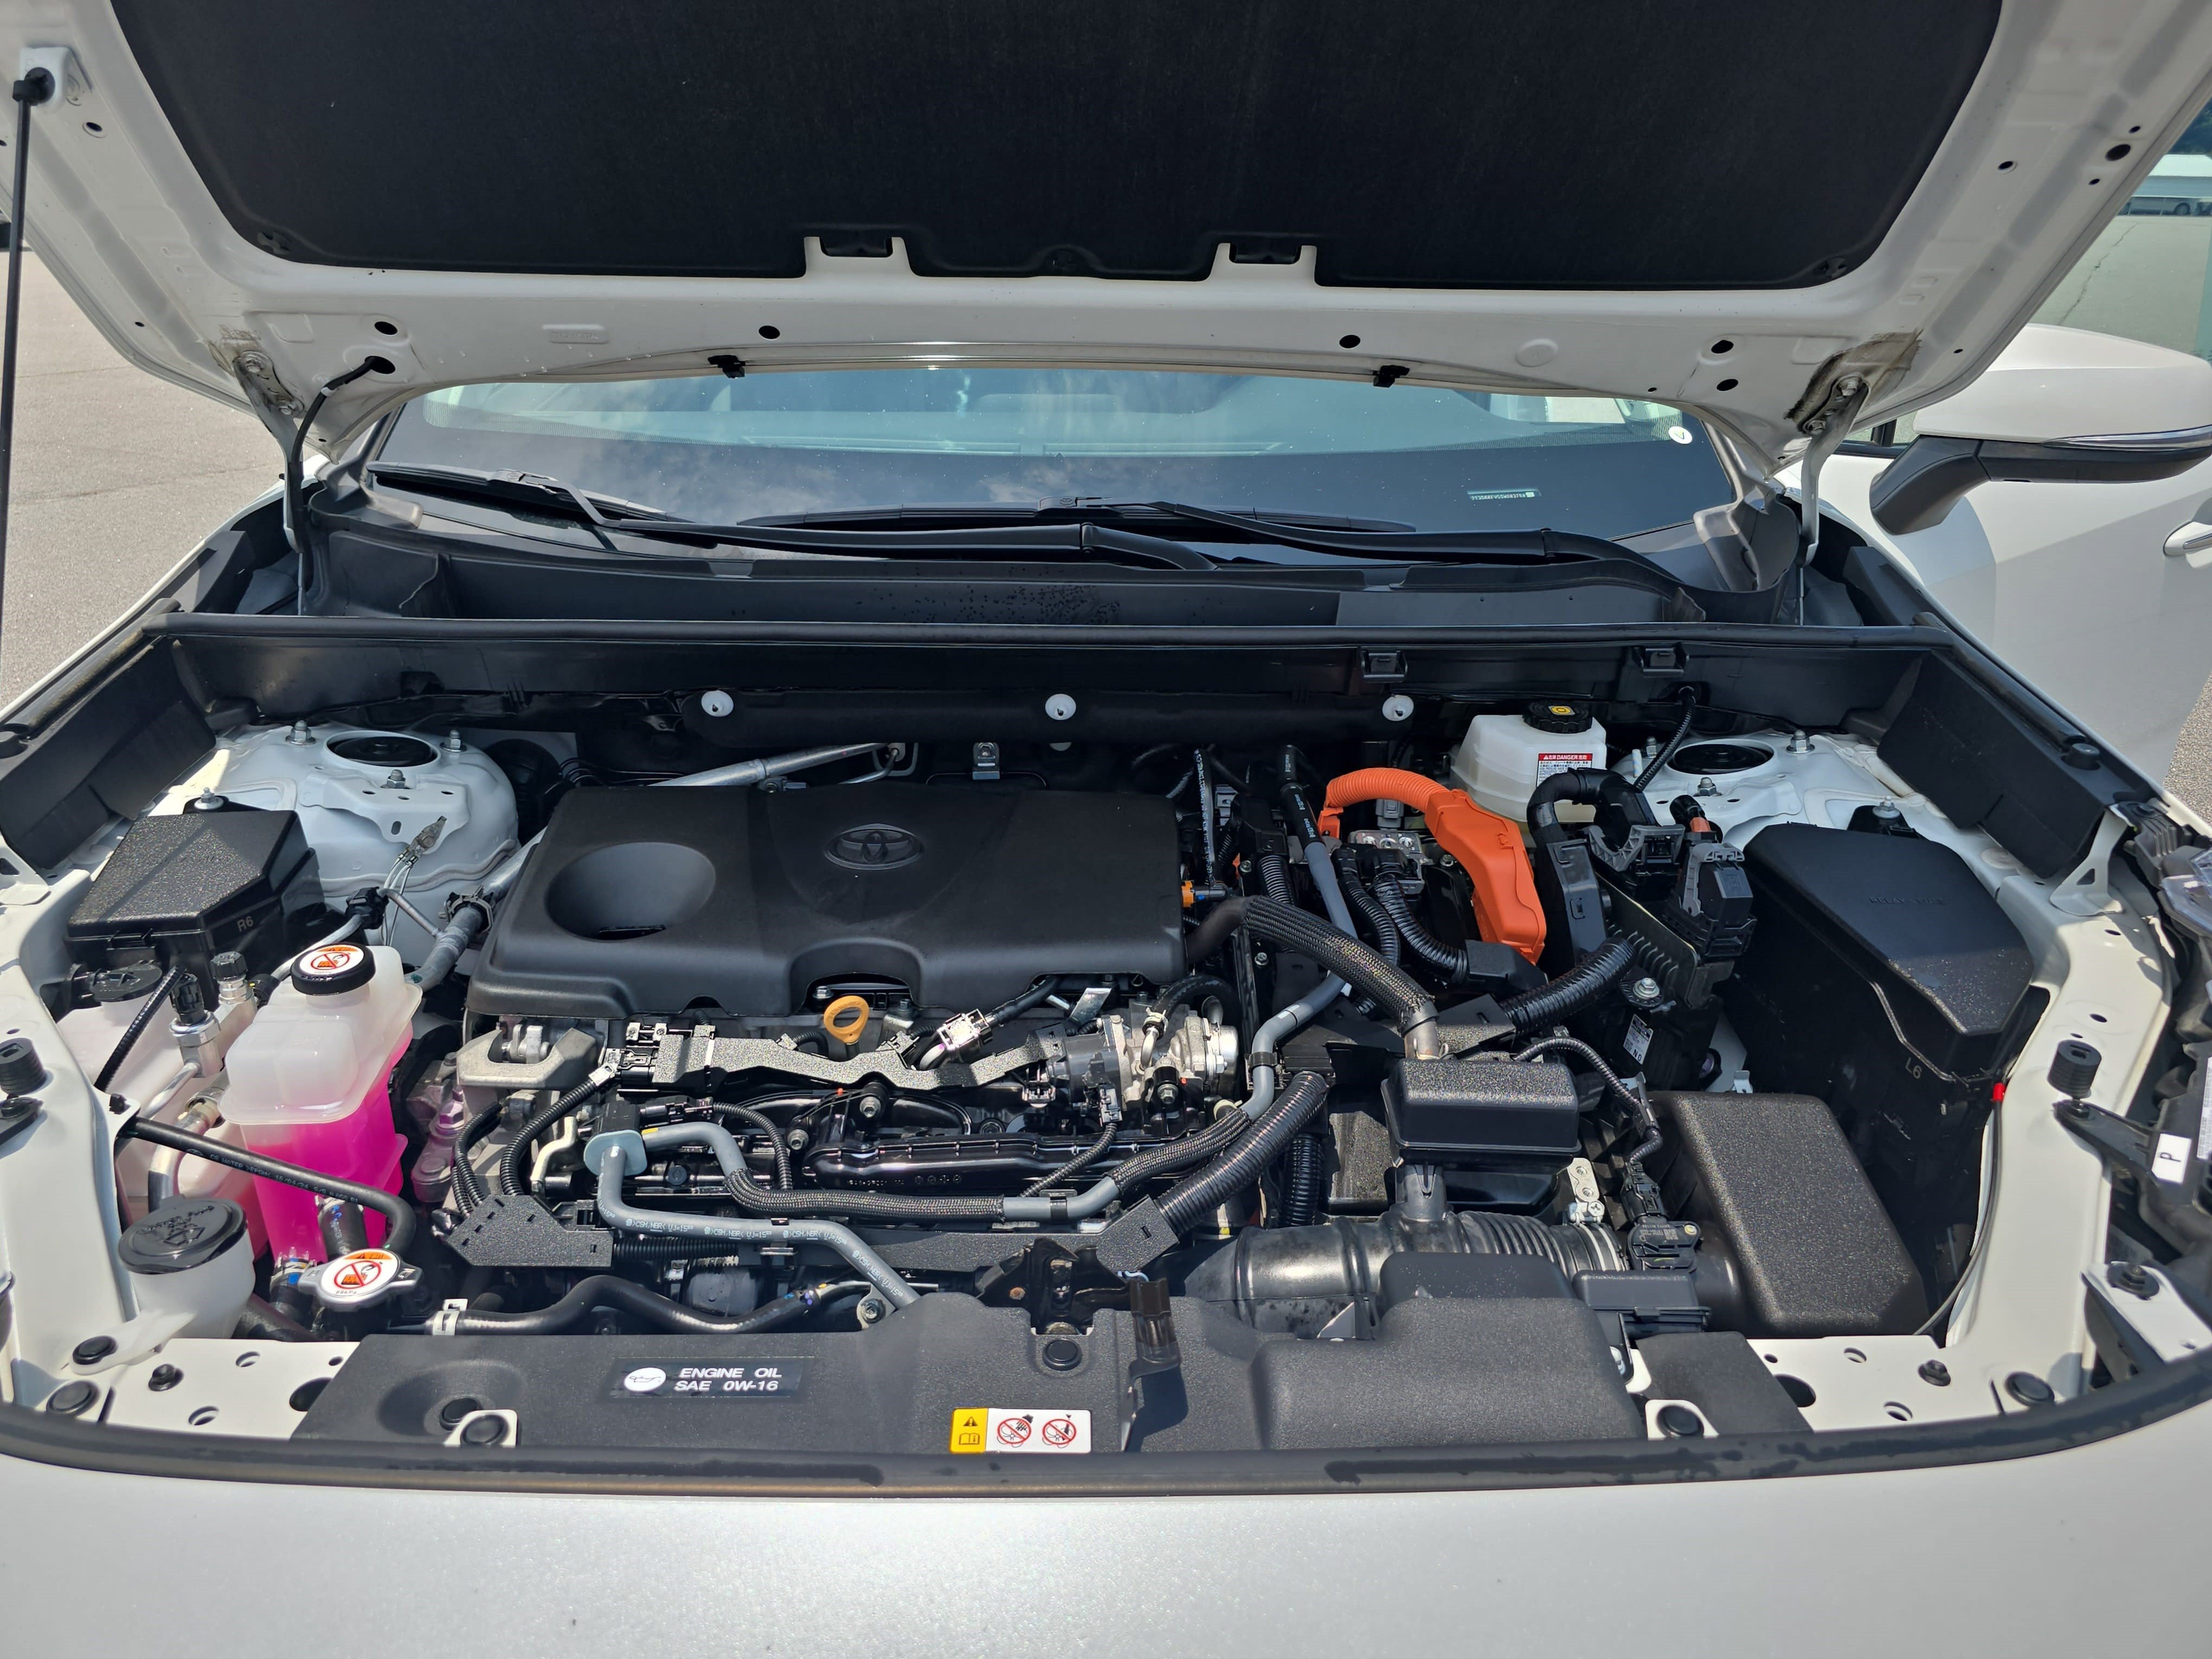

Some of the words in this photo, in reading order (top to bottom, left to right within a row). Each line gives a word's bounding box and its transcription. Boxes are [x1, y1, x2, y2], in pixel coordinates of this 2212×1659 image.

[237, 916, 254, 933] R6
[1905, 1057, 1922, 1079] L6
[678, 1368, 744, 1378] ENGINE
[754, 1368, 782, 1378] OIL
[674, 1380, 712, 1391] SAE
[723, 1380, 779, 1391] 0W-16
